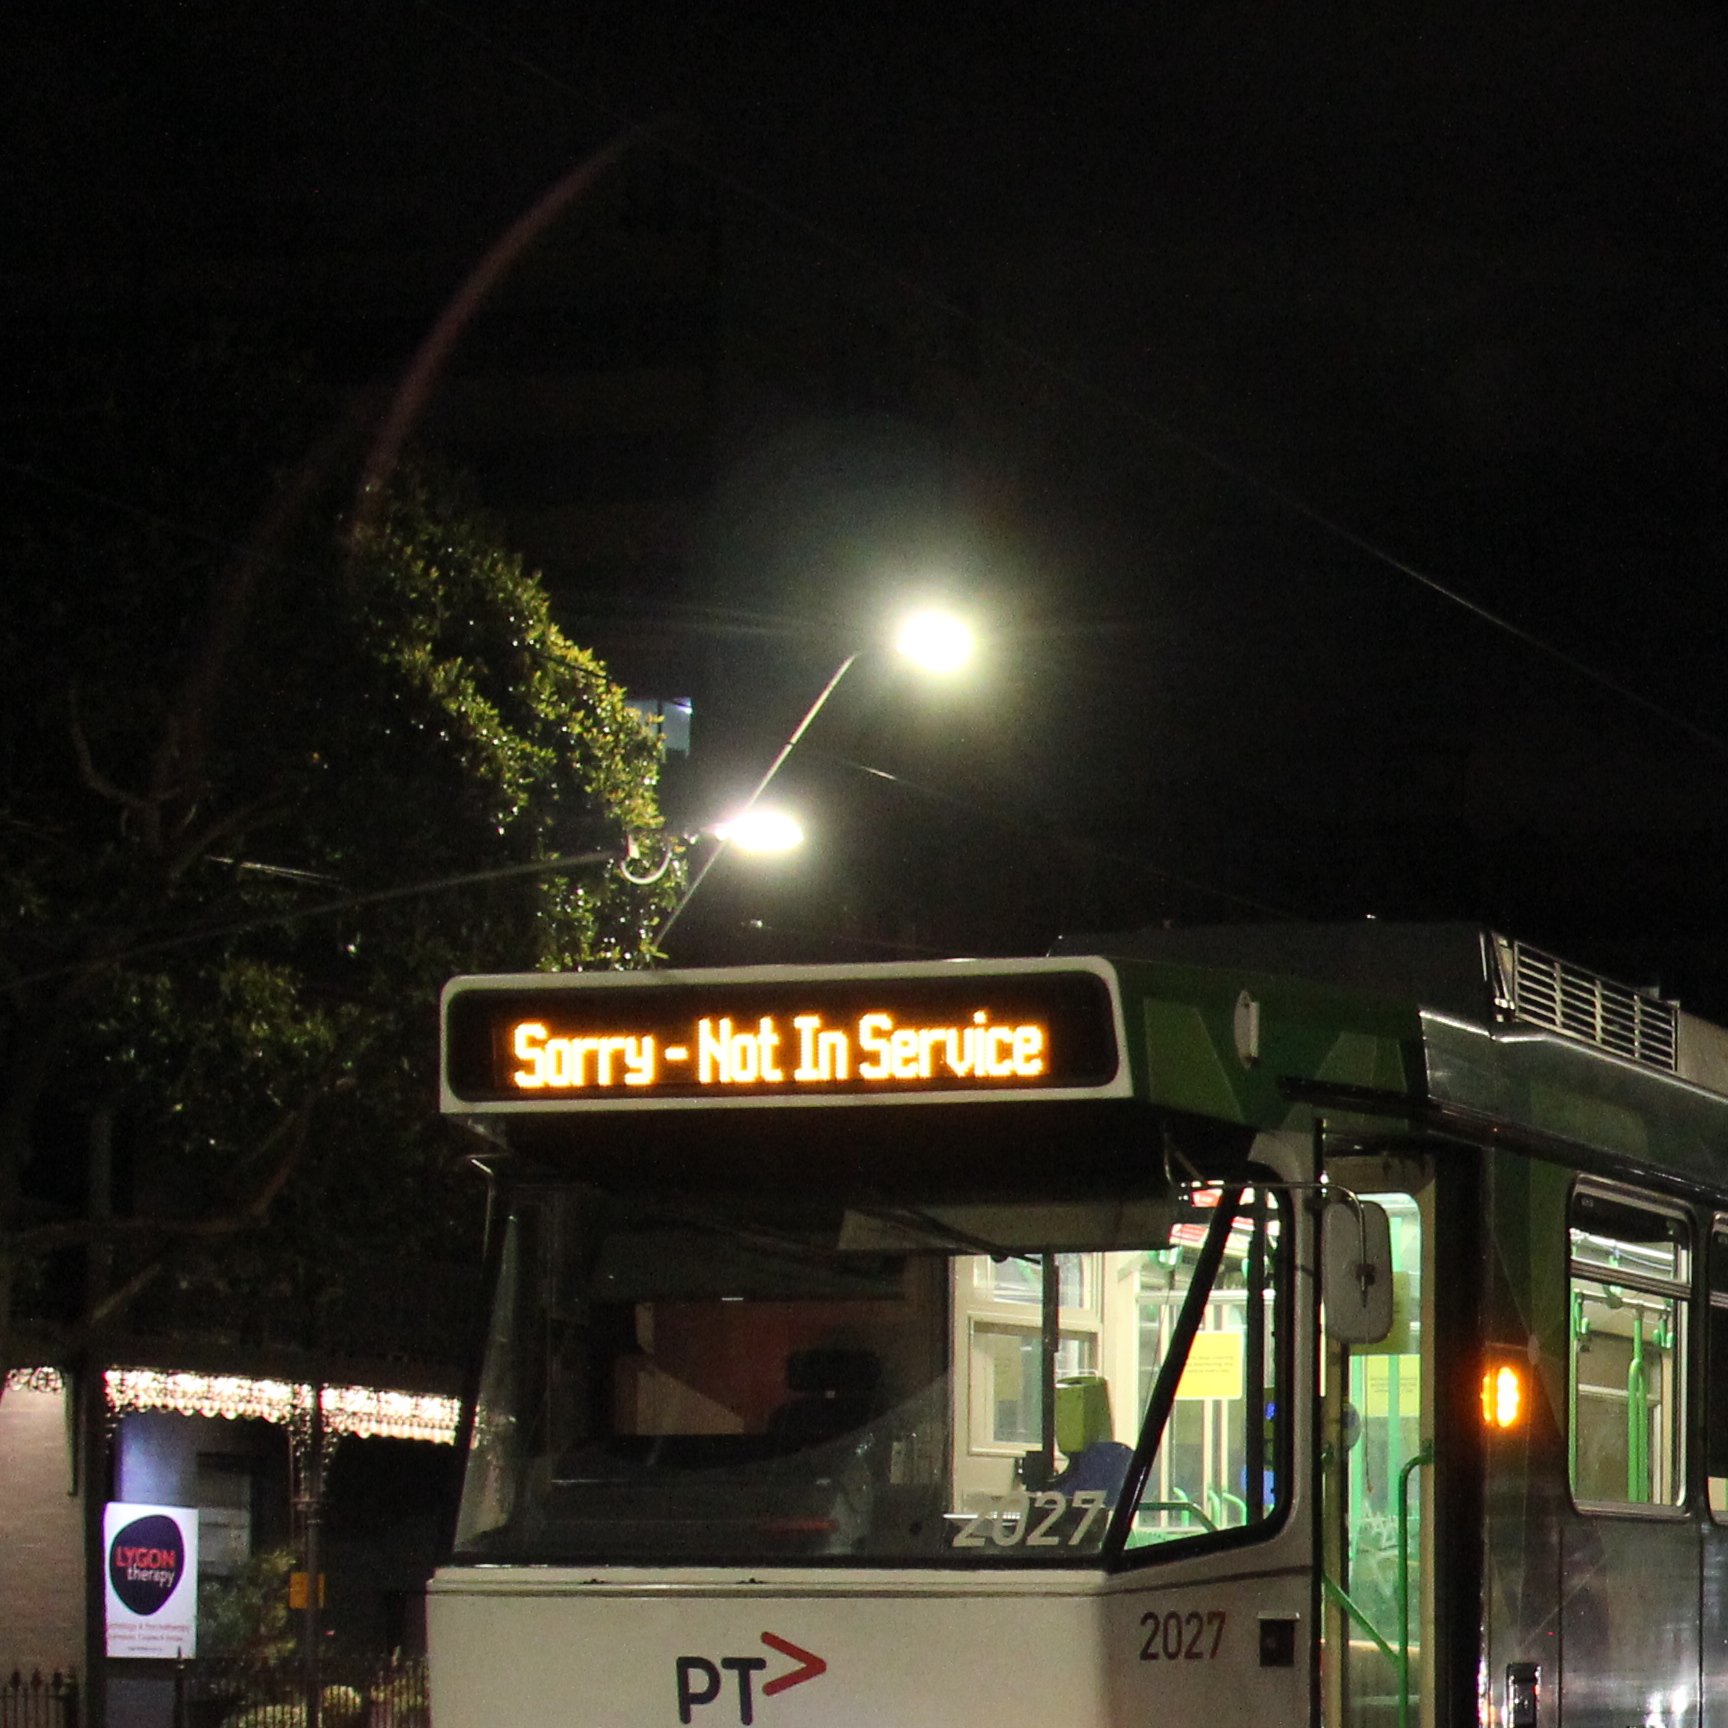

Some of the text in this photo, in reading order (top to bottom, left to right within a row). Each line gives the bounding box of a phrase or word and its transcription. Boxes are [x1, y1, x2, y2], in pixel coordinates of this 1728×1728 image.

[513, 1022, 654, 1087] Sorry
[698, 1016, 782, 1083] Not
[793, 1015, 848, 1080] In
[858, 1010, 1045, 1080] Service
[949, 1490, 1108, 1547] 2027
[115, 1547, 176, 1569] LYGON
[127, 1563, 175, 1588] therapy
[1140, 1611, 1226, 1660] 2027
